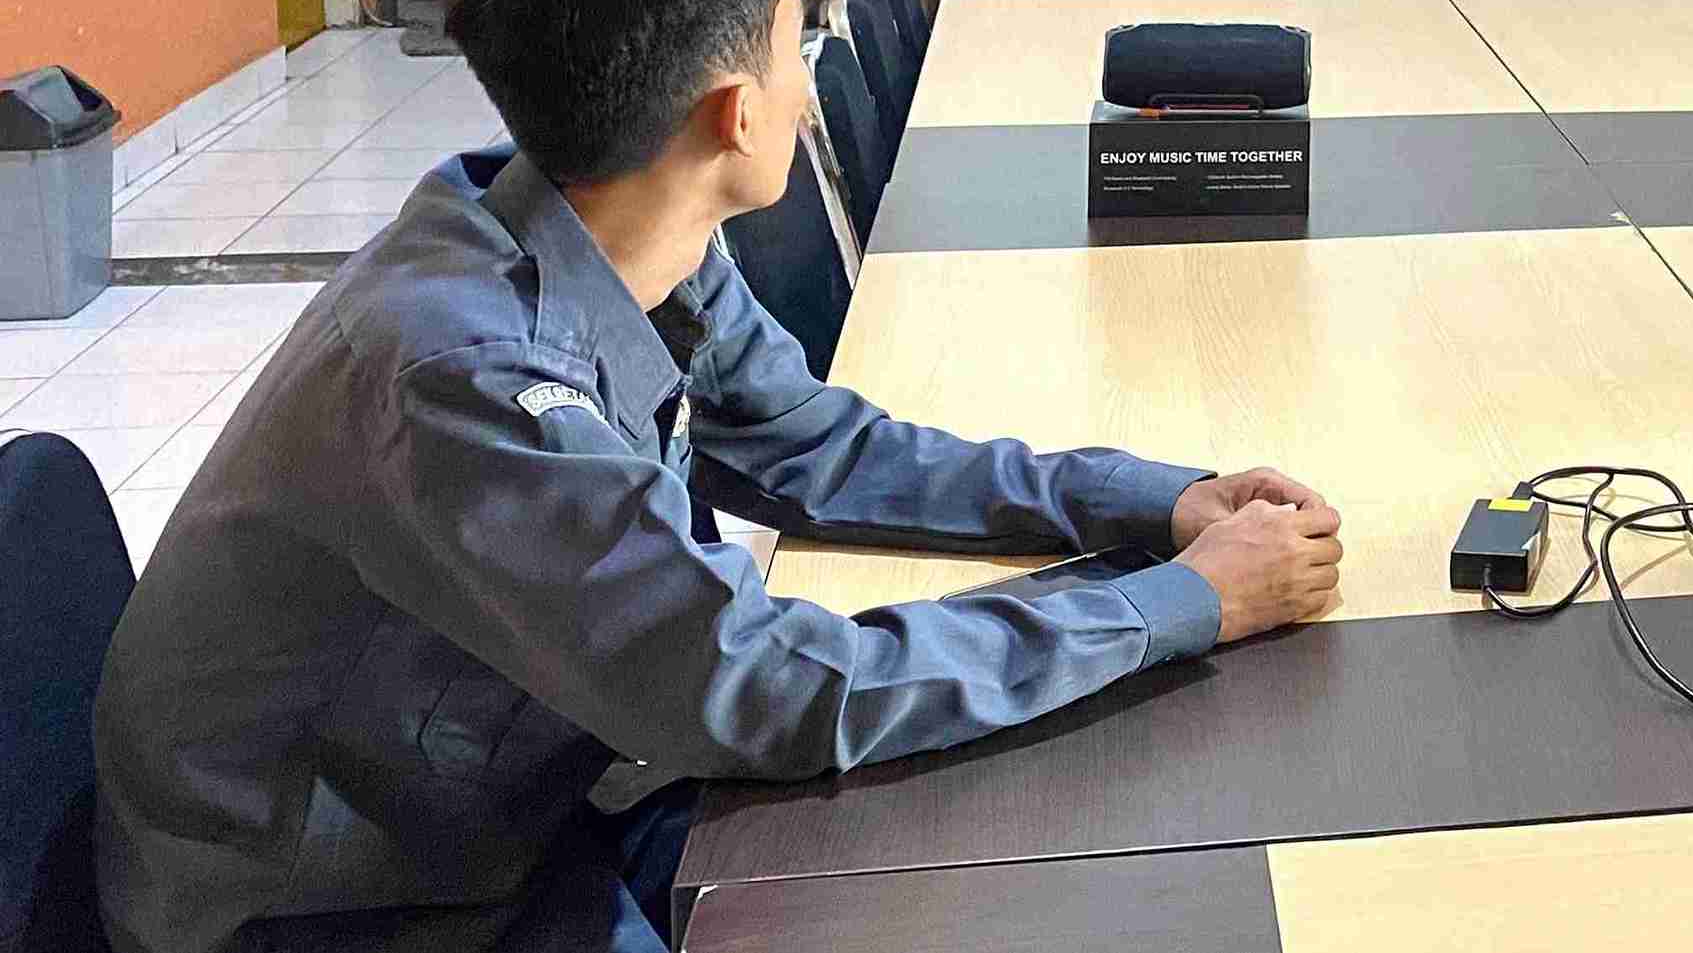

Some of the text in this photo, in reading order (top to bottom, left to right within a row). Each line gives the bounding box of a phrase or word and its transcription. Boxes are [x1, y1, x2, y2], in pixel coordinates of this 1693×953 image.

[1100, 151, 1304, 164] ENJOY MUSIC TIME TOGETHER
